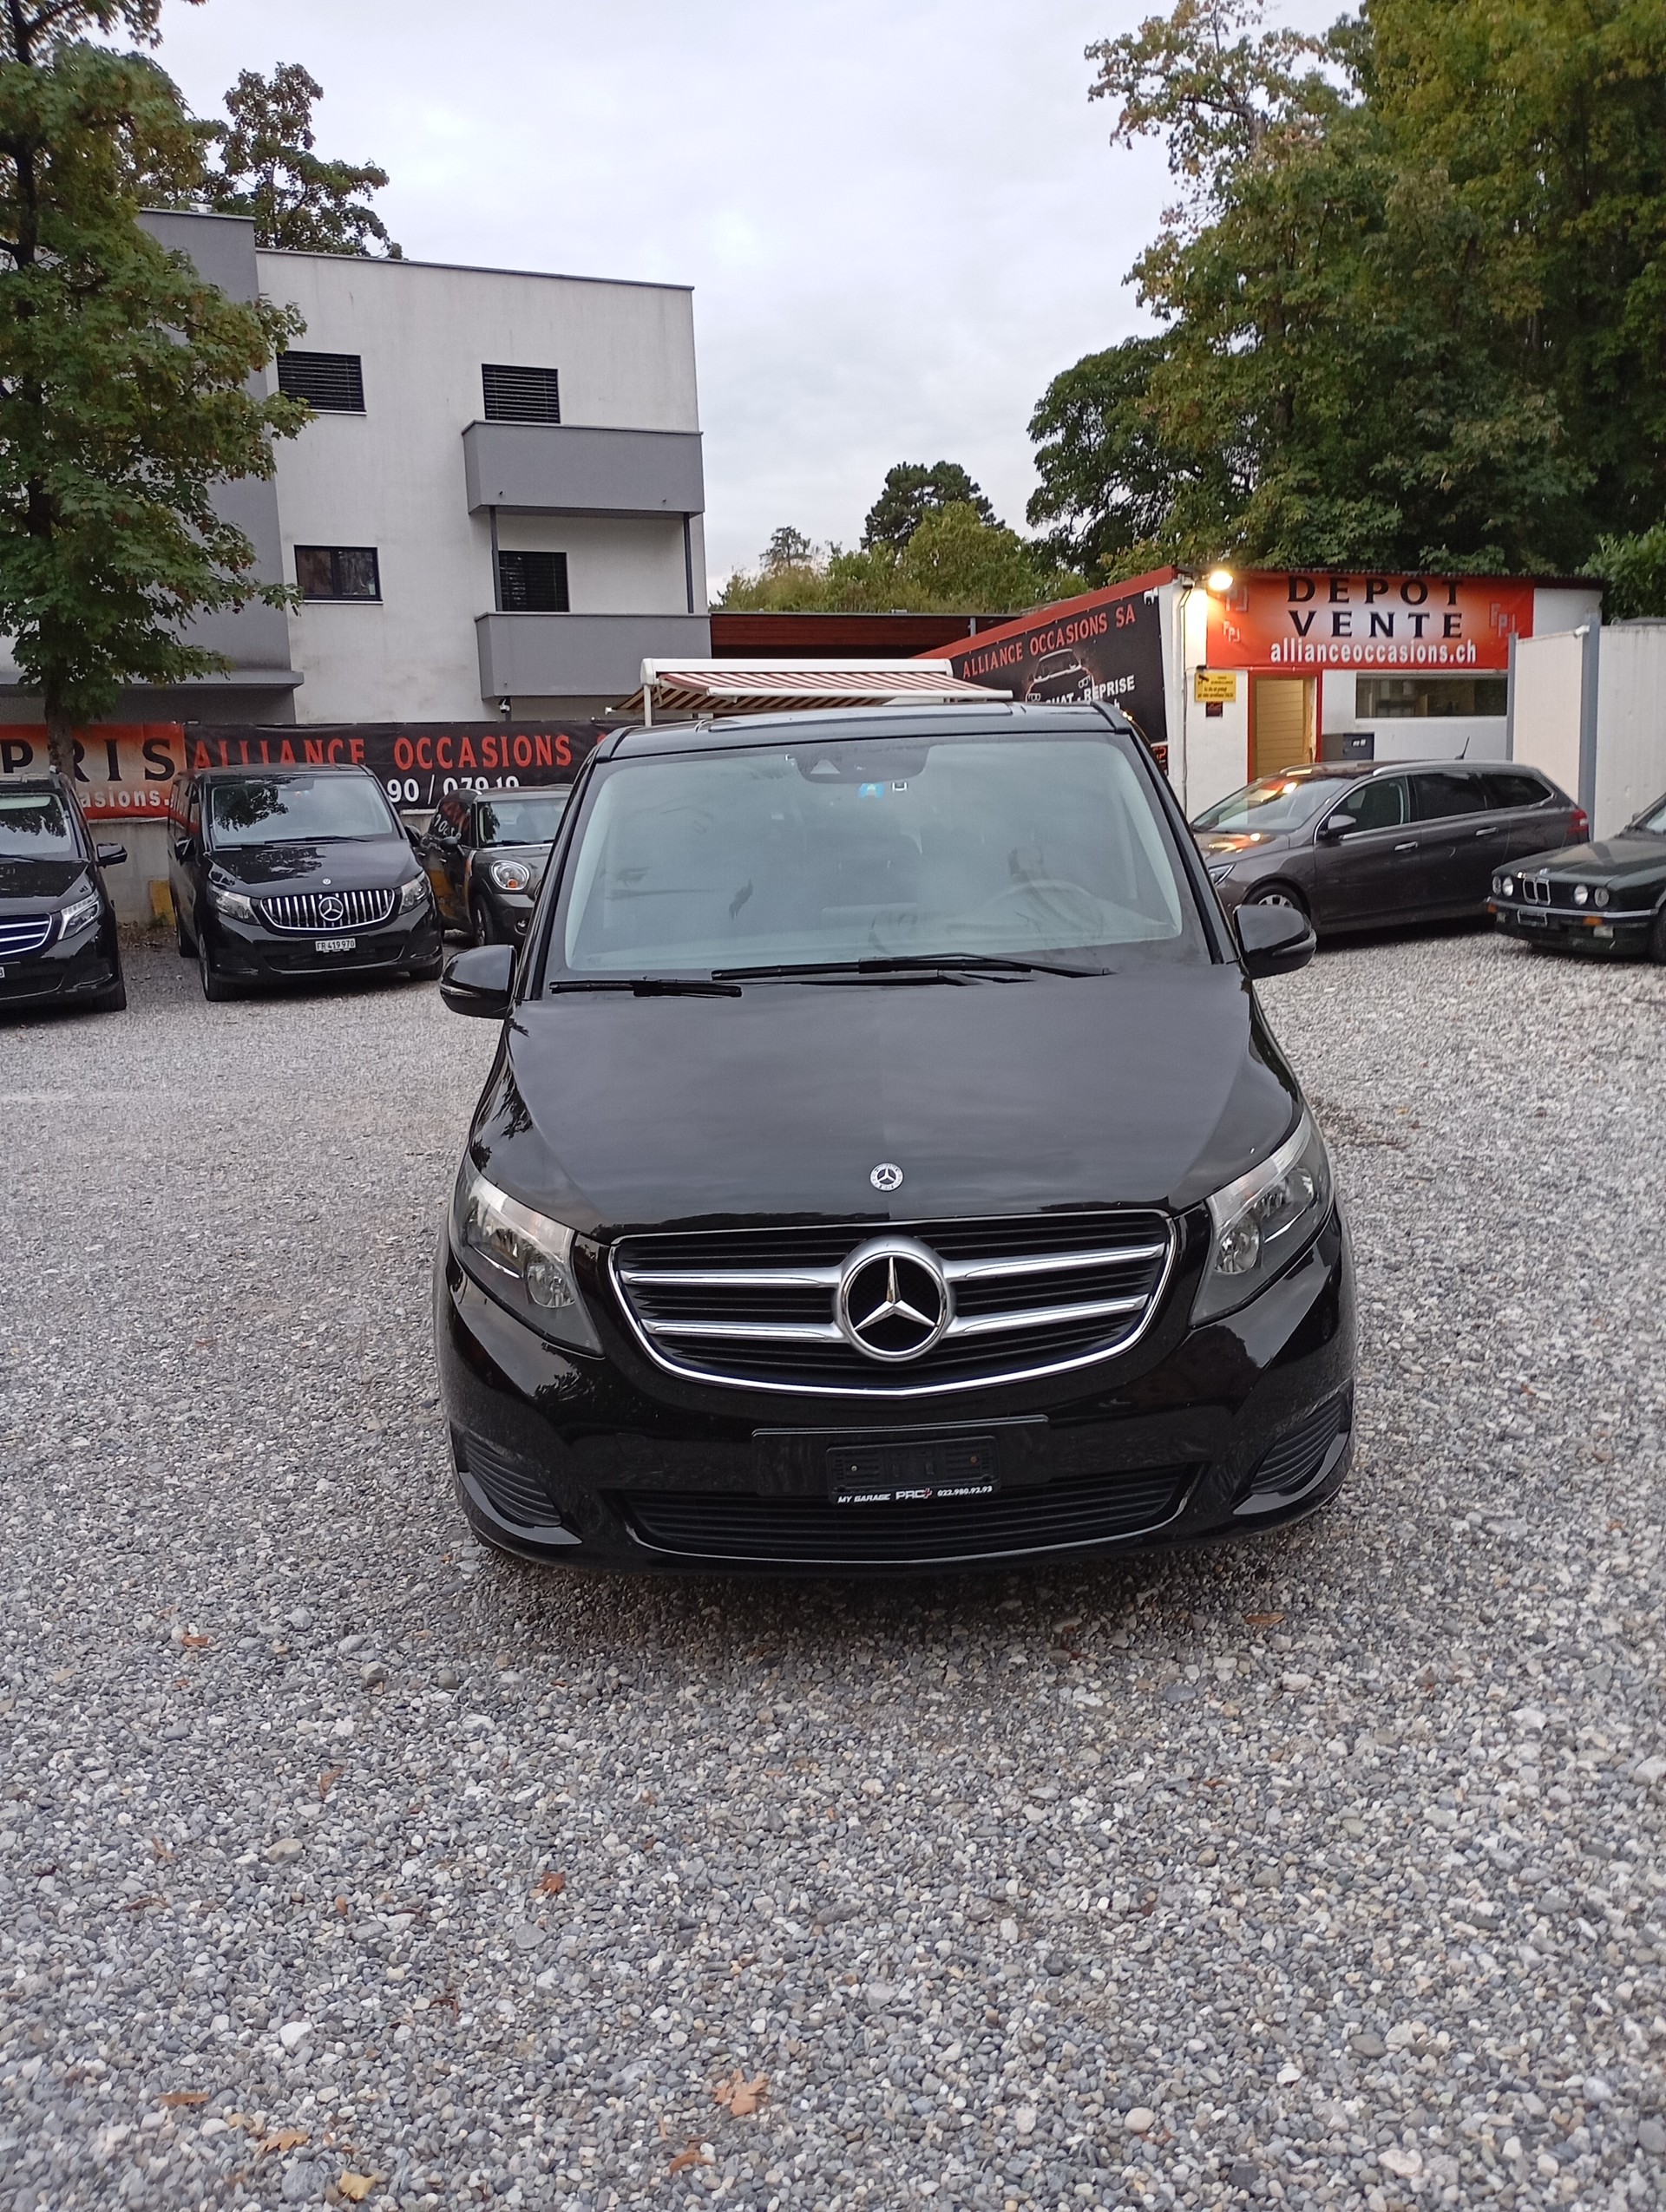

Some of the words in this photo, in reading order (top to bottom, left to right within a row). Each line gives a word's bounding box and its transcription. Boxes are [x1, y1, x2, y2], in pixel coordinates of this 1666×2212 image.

[1287, 575, 1464, 605] DEPOT
[1287, 610, 1463, 638] VENTE
[962, 642, 1023, 678] ALLIANCE
[1029, 613, 1108, 656] OCCASIONS
[1115, 604, 1136, 628] SA
[1269, 637, 1477, 664] allianceoccasions.ch
[1084, 675, 1136, 704] REPRISE
[193, 738, 365, 769] ALLIANCE
[394, 735, 572, 770] OCCASIONS
[854, 1493, 891, 1502] GARAGE
